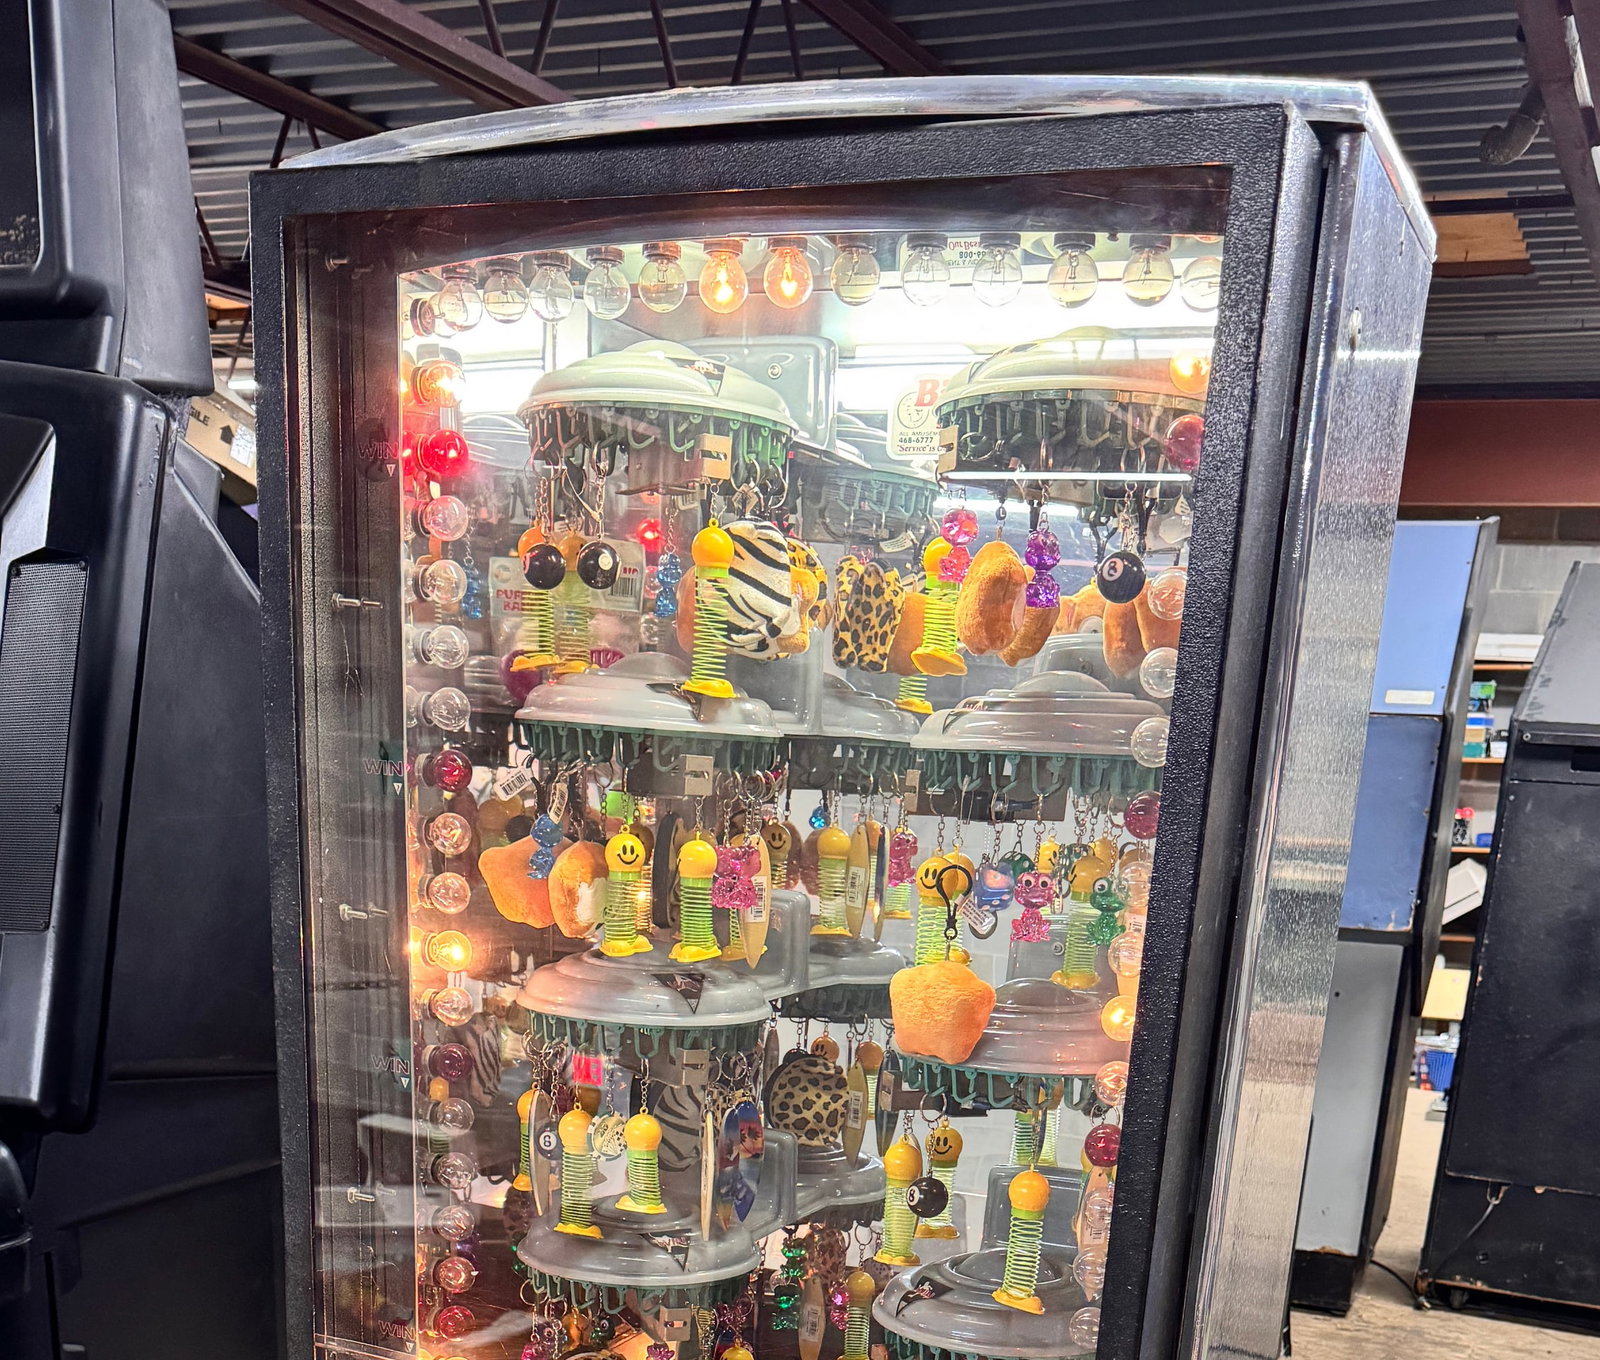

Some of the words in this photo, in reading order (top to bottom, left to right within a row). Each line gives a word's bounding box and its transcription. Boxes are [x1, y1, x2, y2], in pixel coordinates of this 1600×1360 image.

[357, 441, 399, 460] WIN
[362, 758, 404, 777] WIN
[371, 1054, 410, 1075] WIN
[378, 1320, 416, 1341] WIN
